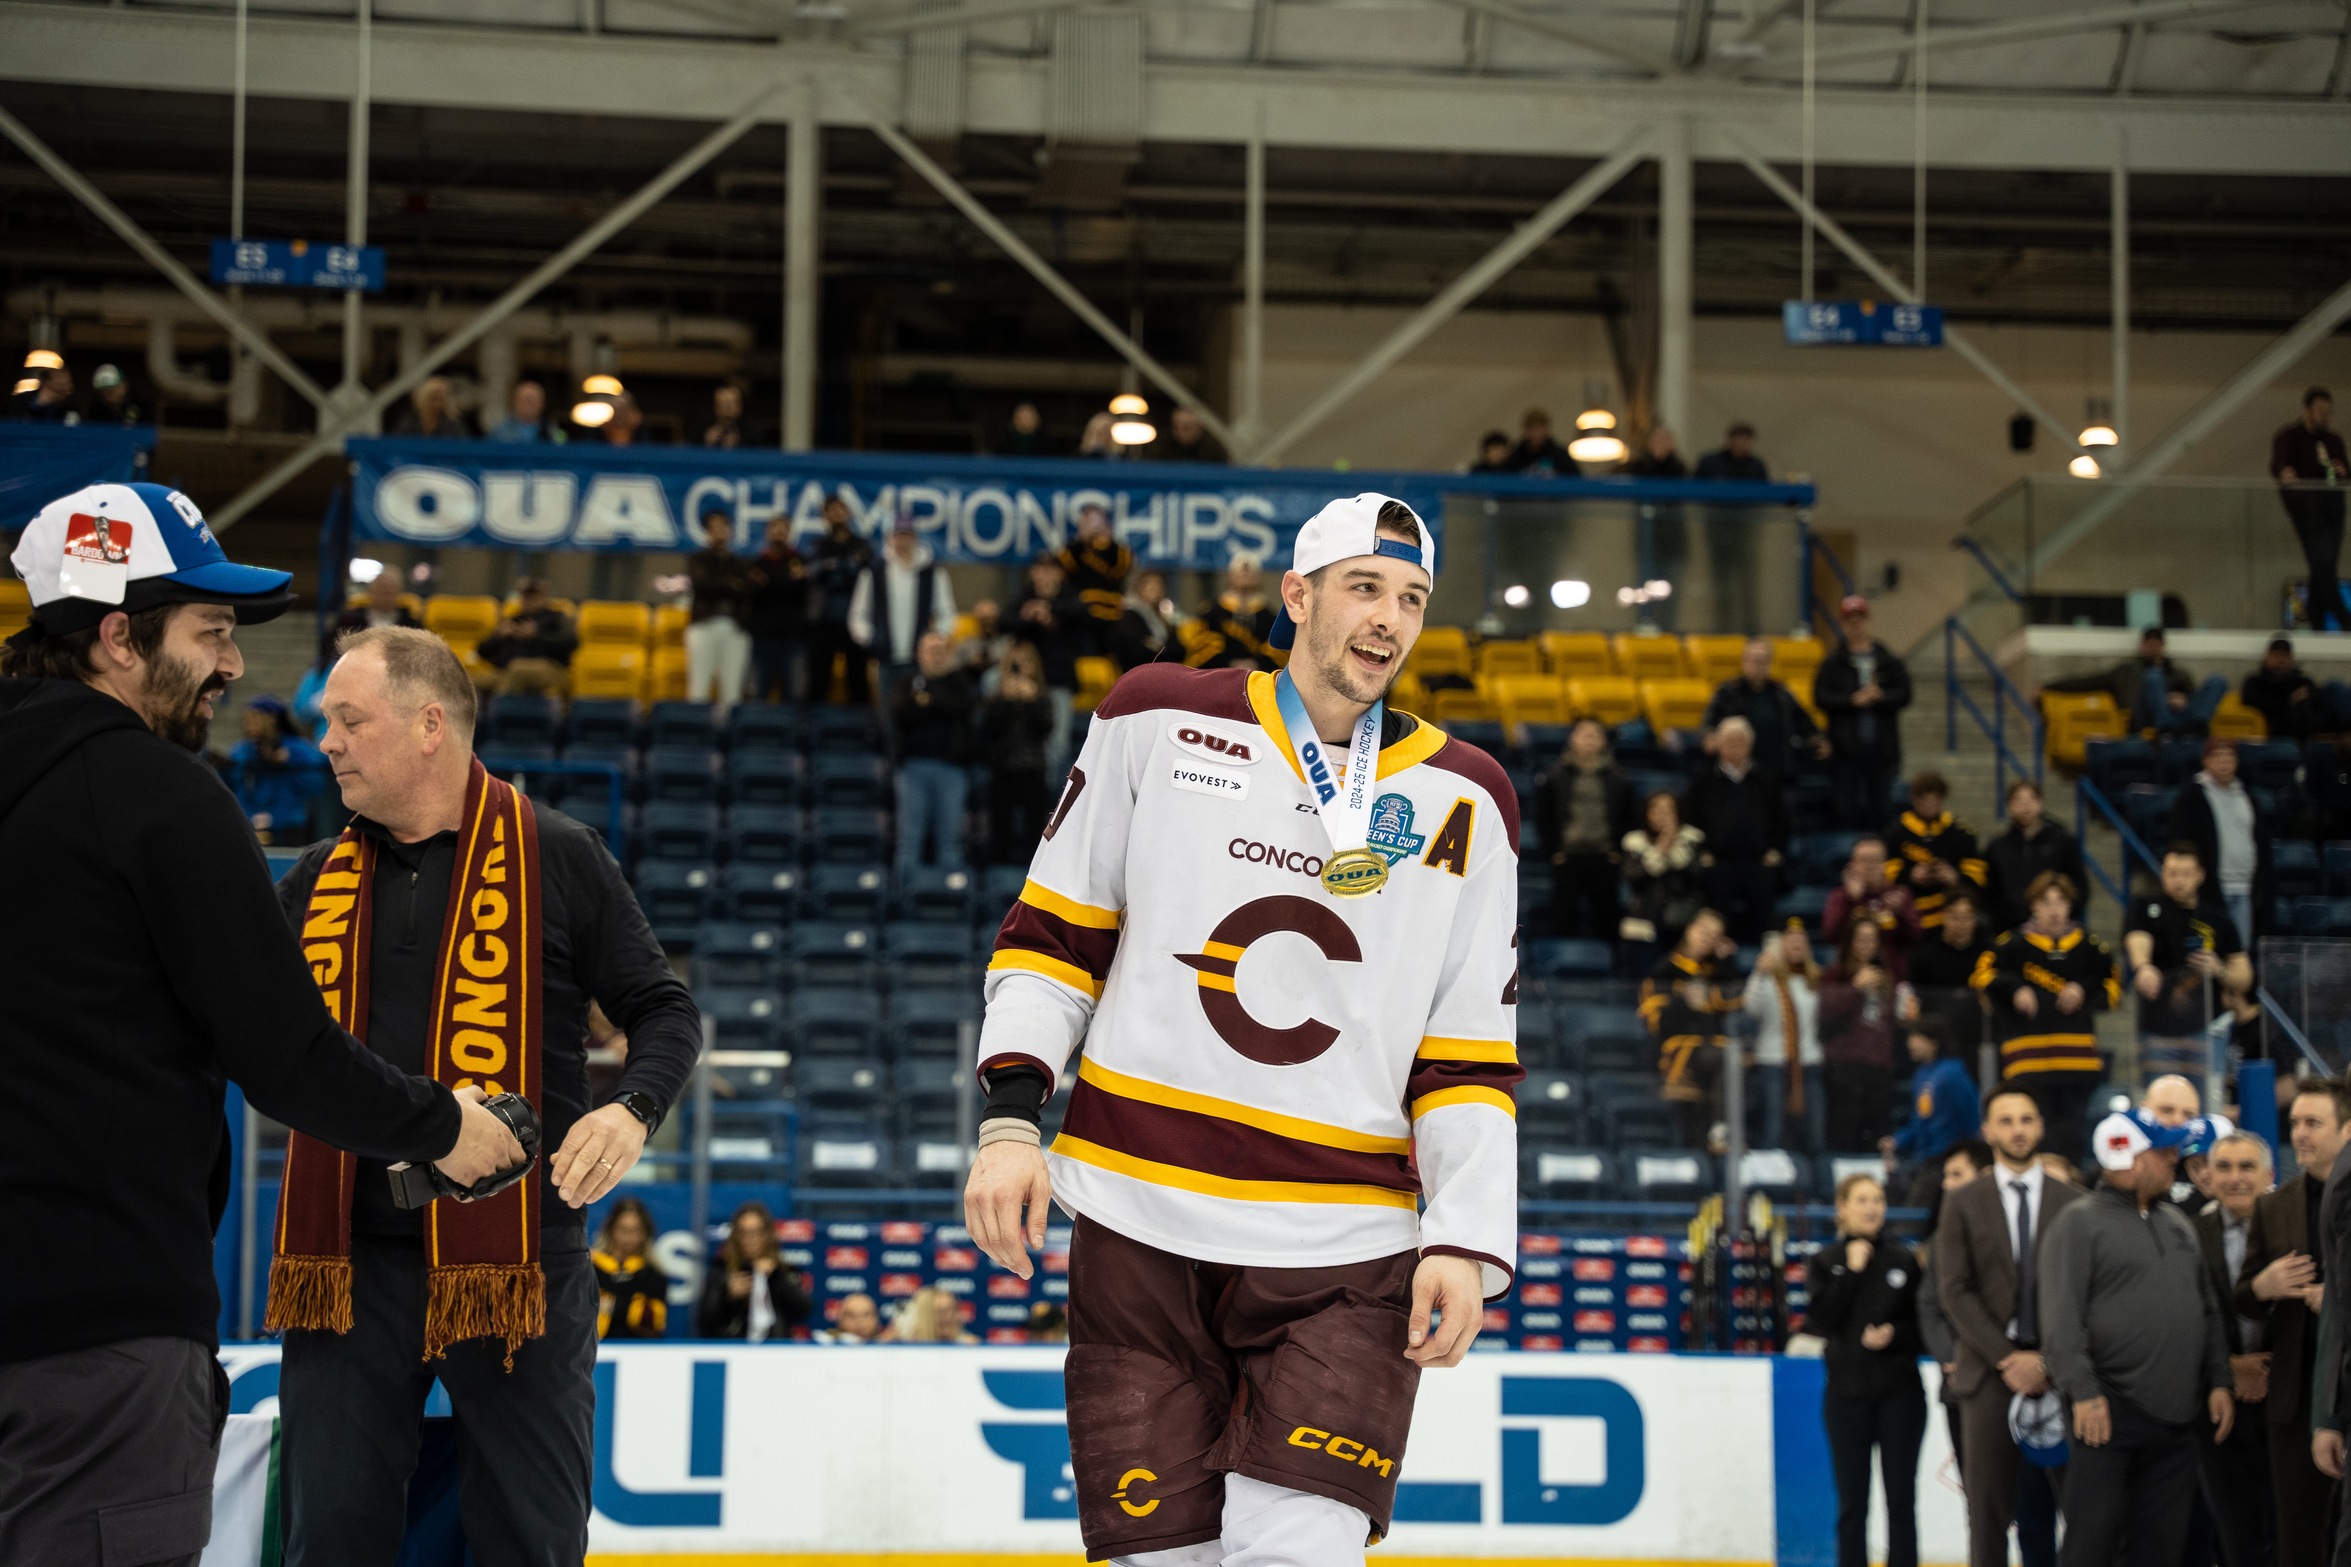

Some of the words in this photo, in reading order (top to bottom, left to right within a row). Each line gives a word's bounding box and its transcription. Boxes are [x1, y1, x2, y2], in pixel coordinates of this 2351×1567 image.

[374, 464, 679, 548] OUA
[1177, 727, 1252, 761] OUA
[1358, 716, 1376, 756] HOCKEY
[1173, 770, 1228, 788] EVOVEST
[1302, 741, 1337, 807] OUA
[1356, 756, 1368, 772] ICE
[1349, 773, 1366, 810] 2024-25
[1367, 829, 1396, 845] EEN'S
[1397, 836, 1419, 849] CUP
[1422, 796, 1476, 877] A
[1228, 838, 1324, 877] CONCO
[1327, 868, 1383, 882] OUA
[1287, 1426, 1394, 1478] CCM
